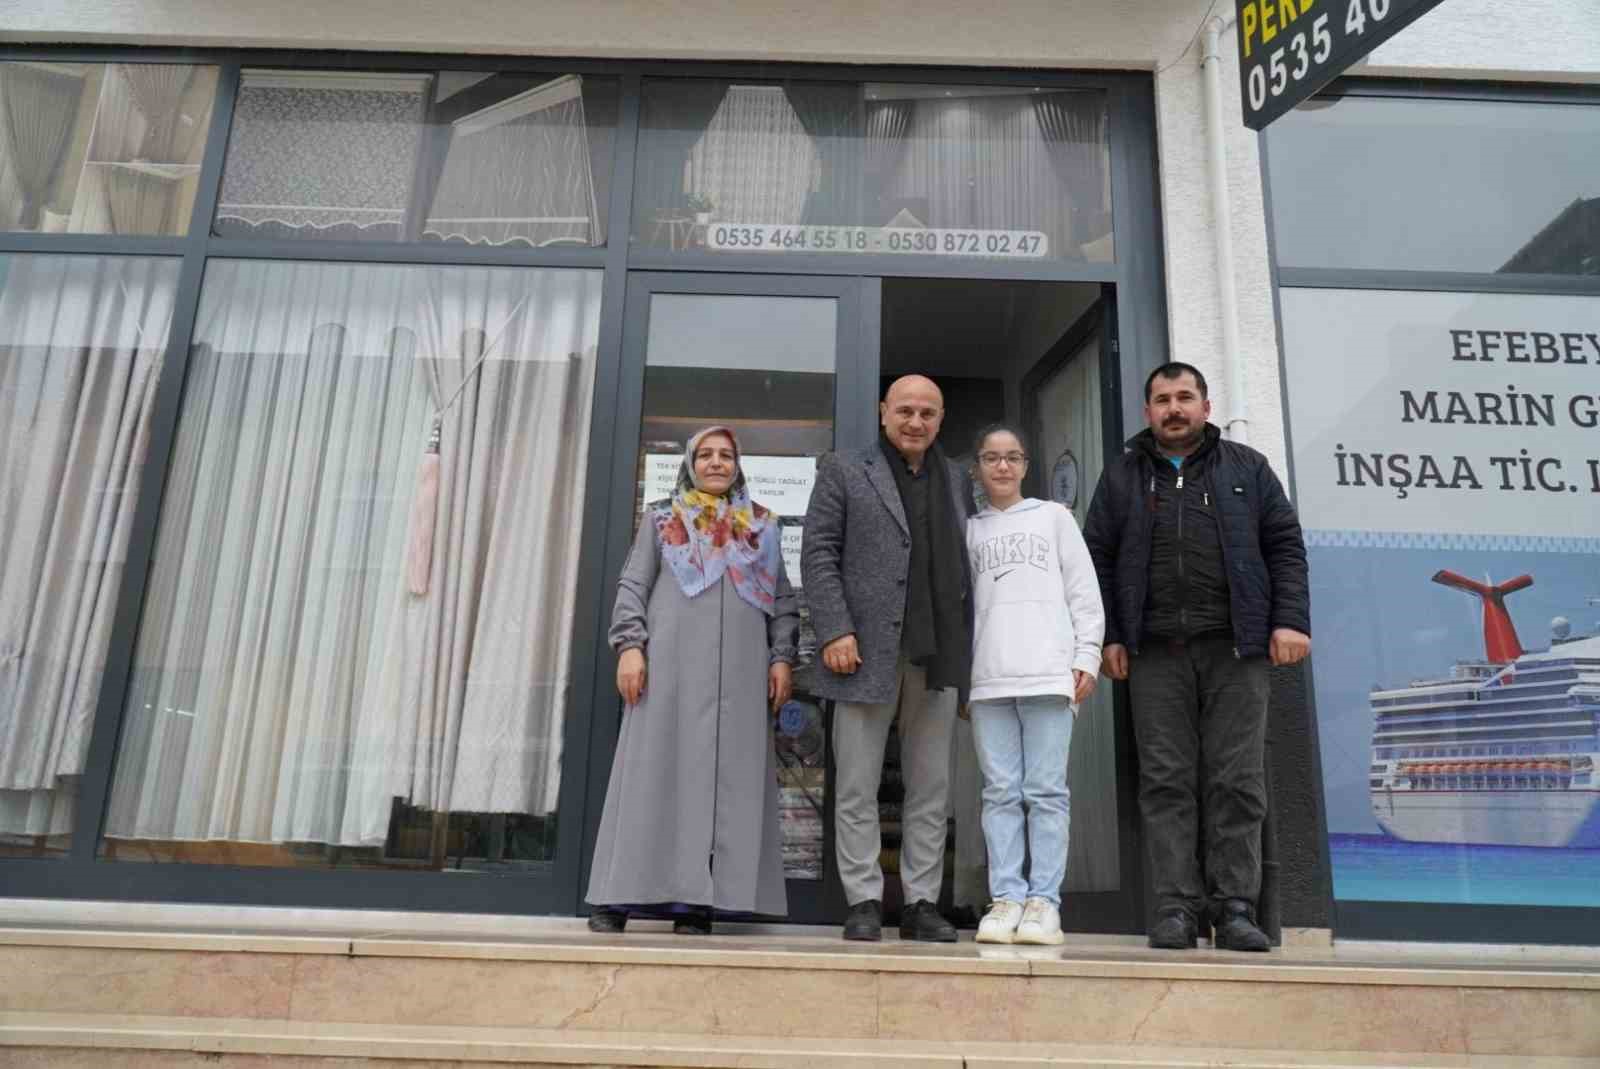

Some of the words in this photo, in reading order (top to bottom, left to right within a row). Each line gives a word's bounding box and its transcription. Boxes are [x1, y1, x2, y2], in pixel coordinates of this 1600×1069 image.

[1249, 12, 1332, 111] 0535
[715, 227, 764, 247] 0535
[769, 229, 807, 248] 464
[814, 230, 836, 249] 55
[847, 231, 868, 250] 18
[888, 232, 937, 251] 0530
[943, 233, 980, 253] 872
[986, 234, 1011, 253] 02
[1016, 235, 1041, 254] 47
[1400, 384, 1556, 427] MARİN
[1568, 394, 1600, 428] G
[1334, 443, 1483, 499] İNŞAA
[1489, 448, 1578, 493] TİC.
